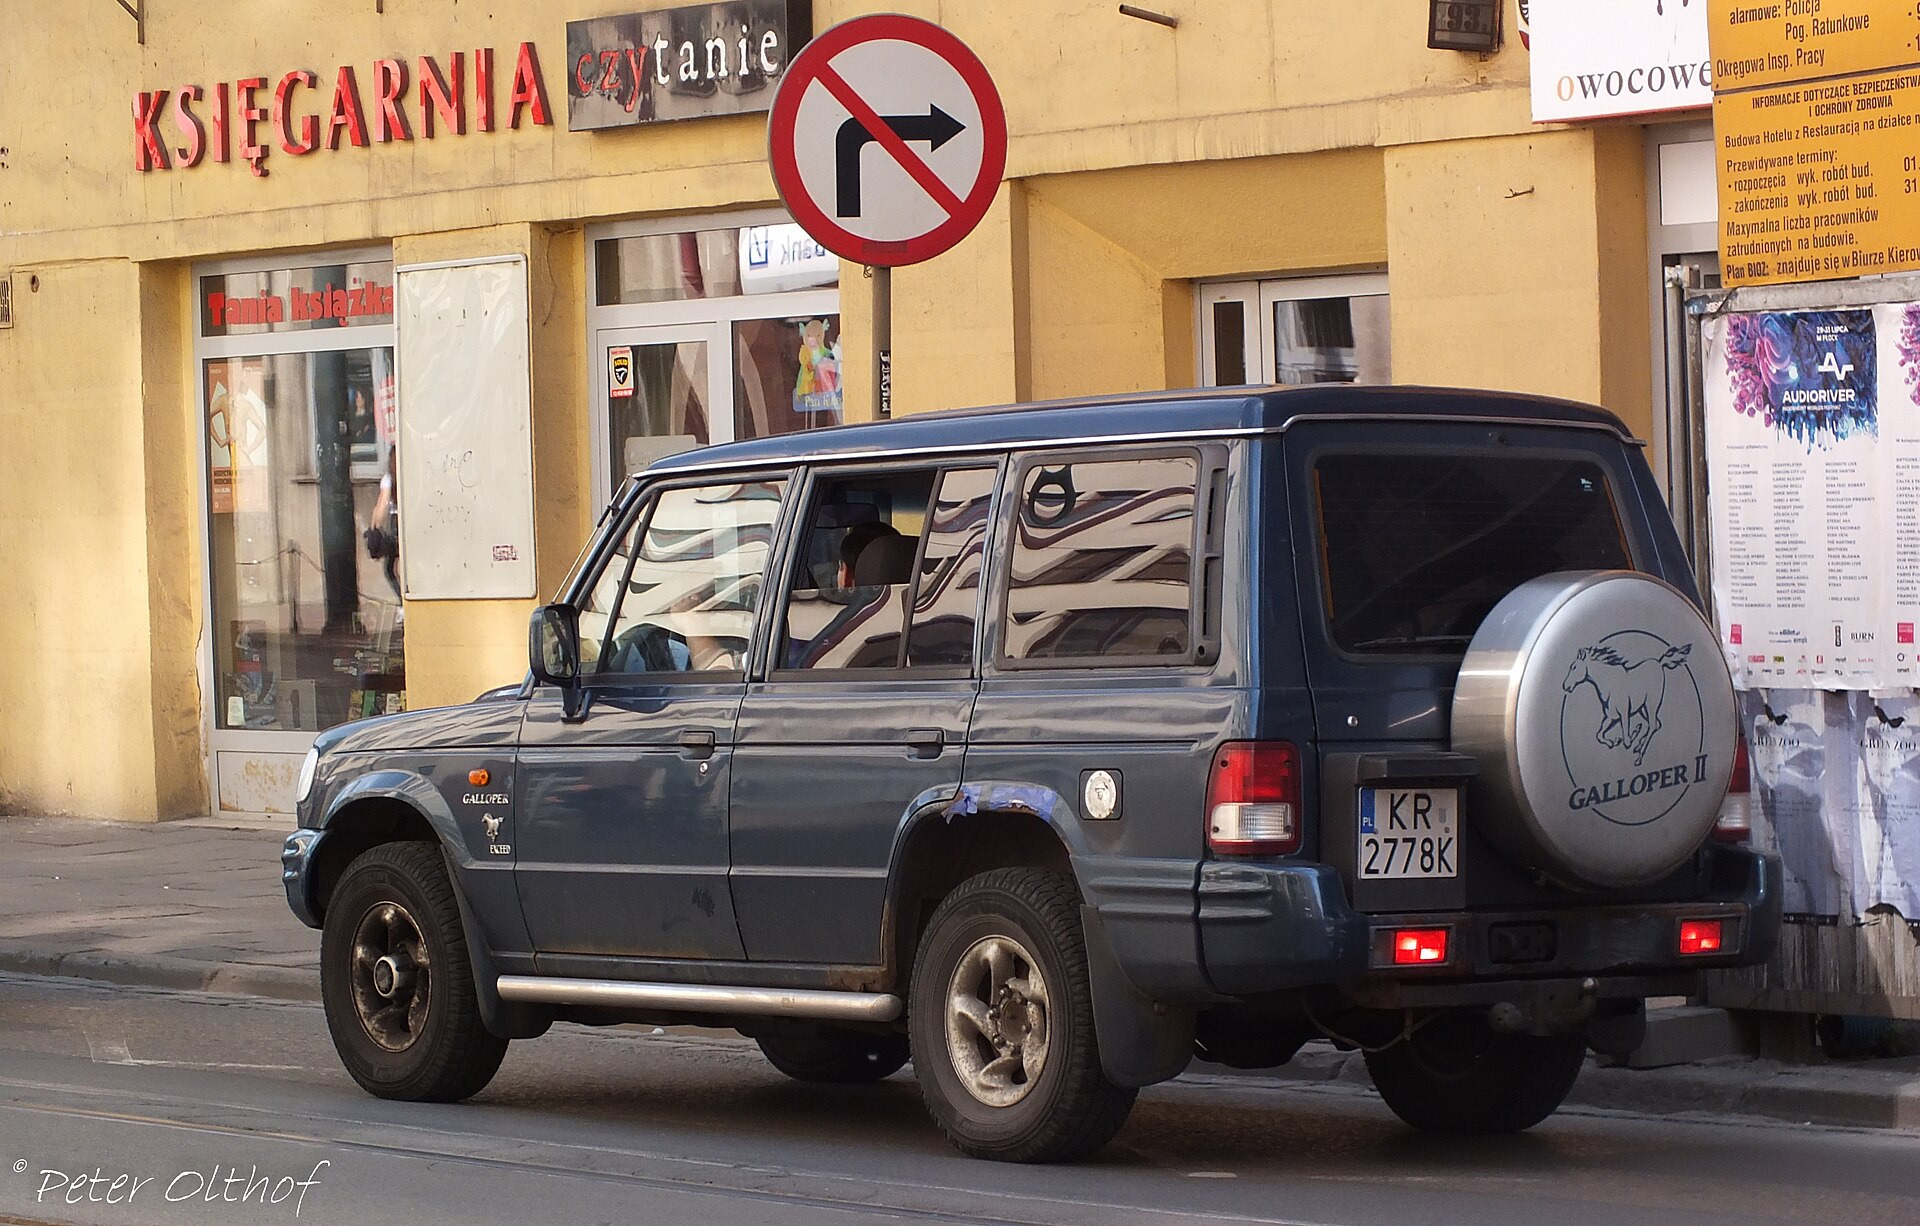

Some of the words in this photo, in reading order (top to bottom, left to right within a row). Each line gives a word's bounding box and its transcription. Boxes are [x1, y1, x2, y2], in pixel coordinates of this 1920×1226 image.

[1729, 5, 1782, 25] alarmowe:
[1785, 0, 1821, 17] Policja
[1785, 22, 1809, 42] Pog.
[1812, 14, 1870, 37] Ratunkowe
[576, 24, 778, 112] czytanie
[1716, 57, 1764, 80] Okręgowa
[1767, 52, 1793, 72] Insp.
[1796, 48, 1825, 67] Pracy
[1557, 60, 1712, 101] owocowe
[132, 41, 554, 177] KSIĘGARNIA
[1752, 91, 1800, 109] INFORMACJE
[1803, 84, 1850, 103] DOTYCZĄCE
[1808, 106, 1812, 117] I
[1815, 100, 1852, 117] OCHRONY
[1856, 95, 1893, 111] ZDROWIA
[1725, 131, 1761, 148] Budowa
[1763, 128, 1792, 144] Hotelu
[1795, 130, 1800, 140] z
[1802, 121, 1860, 138] Restauracją
[1863, 120, 1875, 131] na
[1878, 114, 1911, 129] działce
[1727, 154, 1794, 174] Przewidywane
[1796, 150, 1838, 167] terminy:
[1734, 173, 1786, 194] rozpoczęcia
[1797, 169, 1819, 187] wyk.
[1822, 165, 1849, 183] robót
[1851, 161, 1874, 179] bud.
[1734, 193, 1789, 213] zakończenia
[1797, 191, 1821, 209] wyk.
[1823, 186, 1850, 203] robót
[1855, 183, 1878, 199] bud.
[1727, 218, 1780, 238] Maxymalna
[1783, 213, 1811, 230] liczba
[1814, 207, 1879, 231] pracowników
[1727, 236, 1792, 258] zatrudnionych
[1797, 238, 1810, 250] na
[1813, 231, 1858, 249] budowie.
[1727, 264, 1745, 280] Plan
[1748, 261, 1769, 278] BIOZ:
[1777, 255, 1821, 278] znajduje
[1824, 252, 1839, 274] się
[1841, 254, 1850, 268] w
[1852, 249, 1884, 267] Biurze
[208, 289, 283, 326] Tania
[614, 359, 628, 367] SOLID
[1782, 388, 1855, 404] AUDIORIVER
[1850, 632, 1875, 641] BURN
[1568, 764, 1688, 811] GALLOPER
[1693, 753, 1708, 784] II
[462, 793, 509, 804] GALLOPER
[1389, 793, 1432, 830] KR
[1363, 816, 1374, 827] PL
[489, 844, 511, 855] EXCEED
[1364, 837, 1454, 875] 2778K
